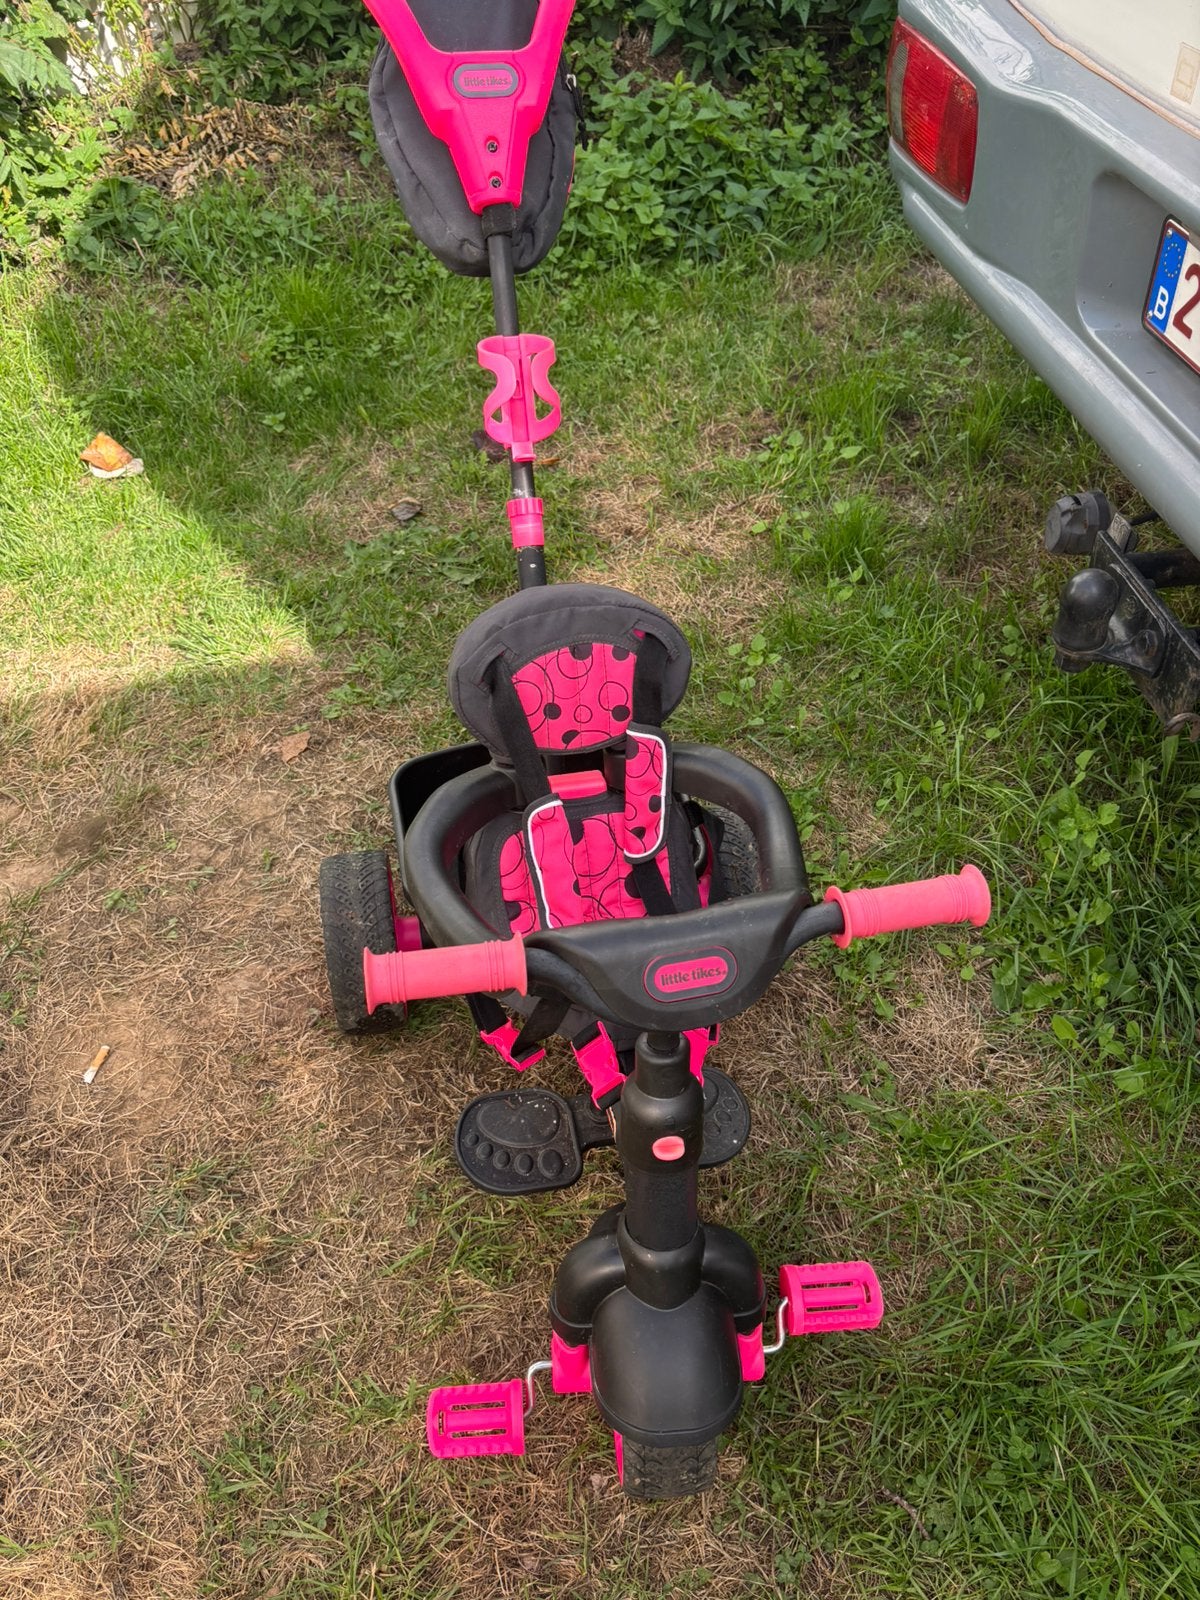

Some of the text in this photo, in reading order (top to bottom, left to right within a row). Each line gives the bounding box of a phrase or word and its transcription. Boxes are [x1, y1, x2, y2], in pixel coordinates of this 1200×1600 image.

[464, 76, 485, 87] little
[1154, 285, 1169, 320] B
[660, 972, 689, 986] little
